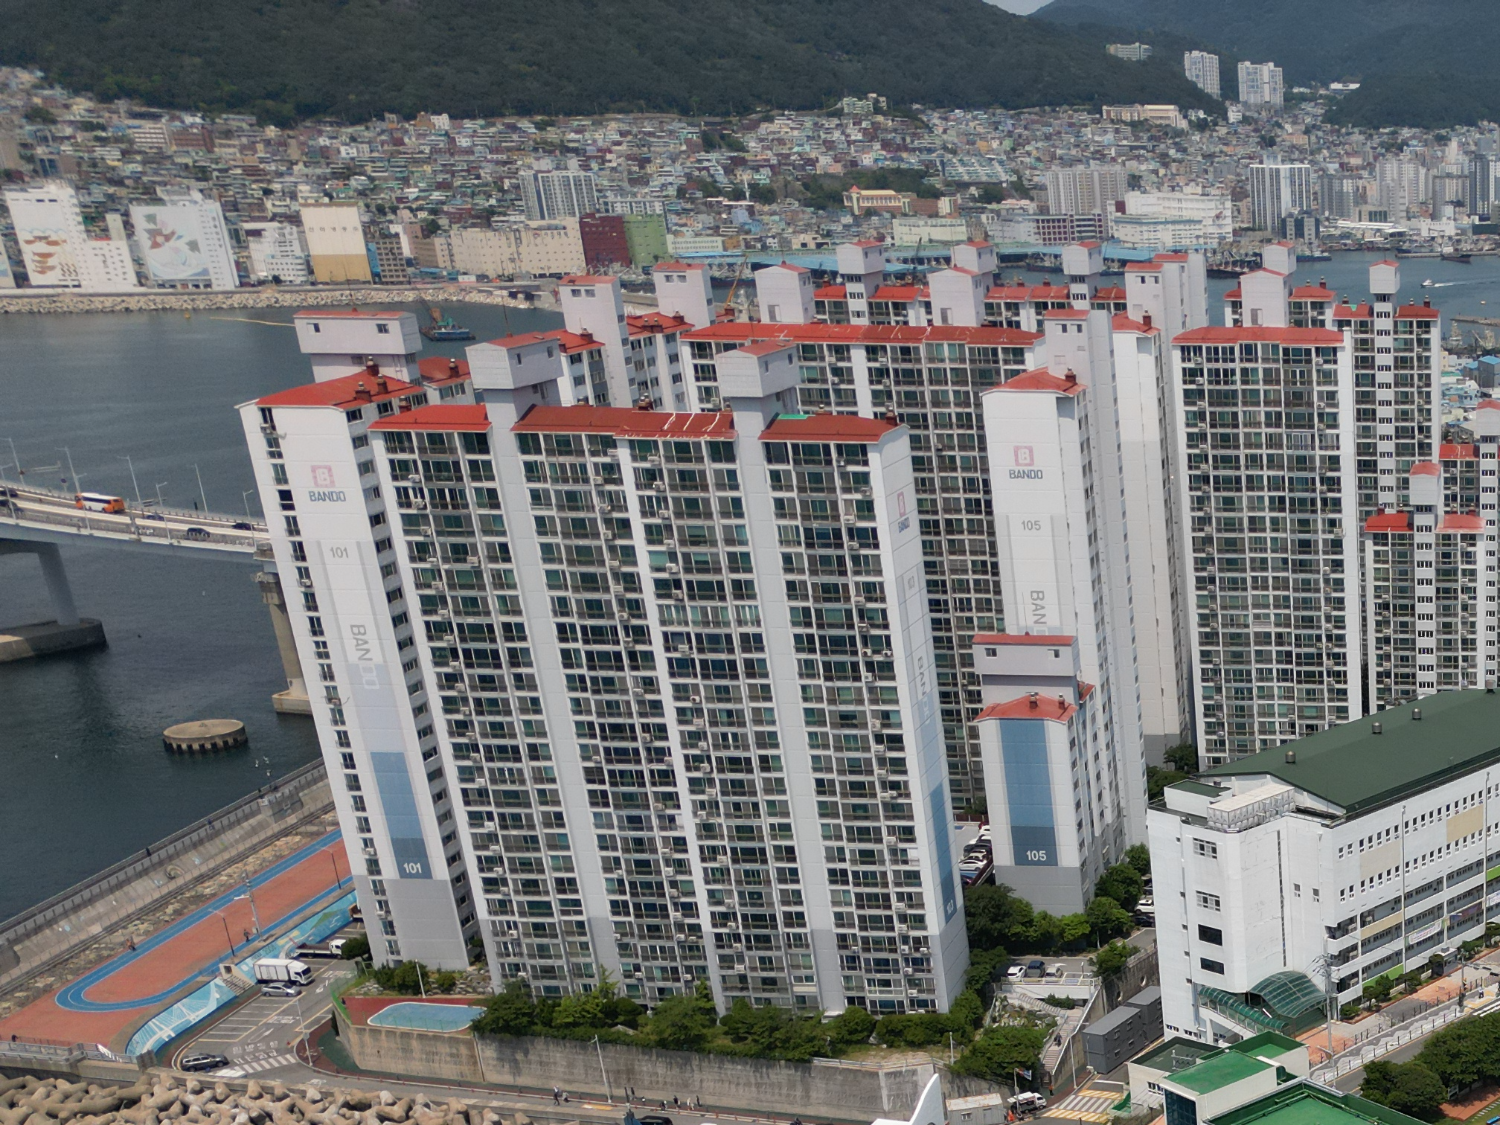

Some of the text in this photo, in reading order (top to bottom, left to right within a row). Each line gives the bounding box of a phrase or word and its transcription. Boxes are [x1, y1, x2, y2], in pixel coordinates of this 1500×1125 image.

[1008, 469, 1043, 480] BANDO
[308, 490, 346, 502] BANDO
[1021, 520, 1041, 531] 105
[329, 546, 349, 559] 101
[350, 624, 380, 690] BANDO
[1026, 850, 1046, 861] 105
[403, 862, 422, 874] 101
